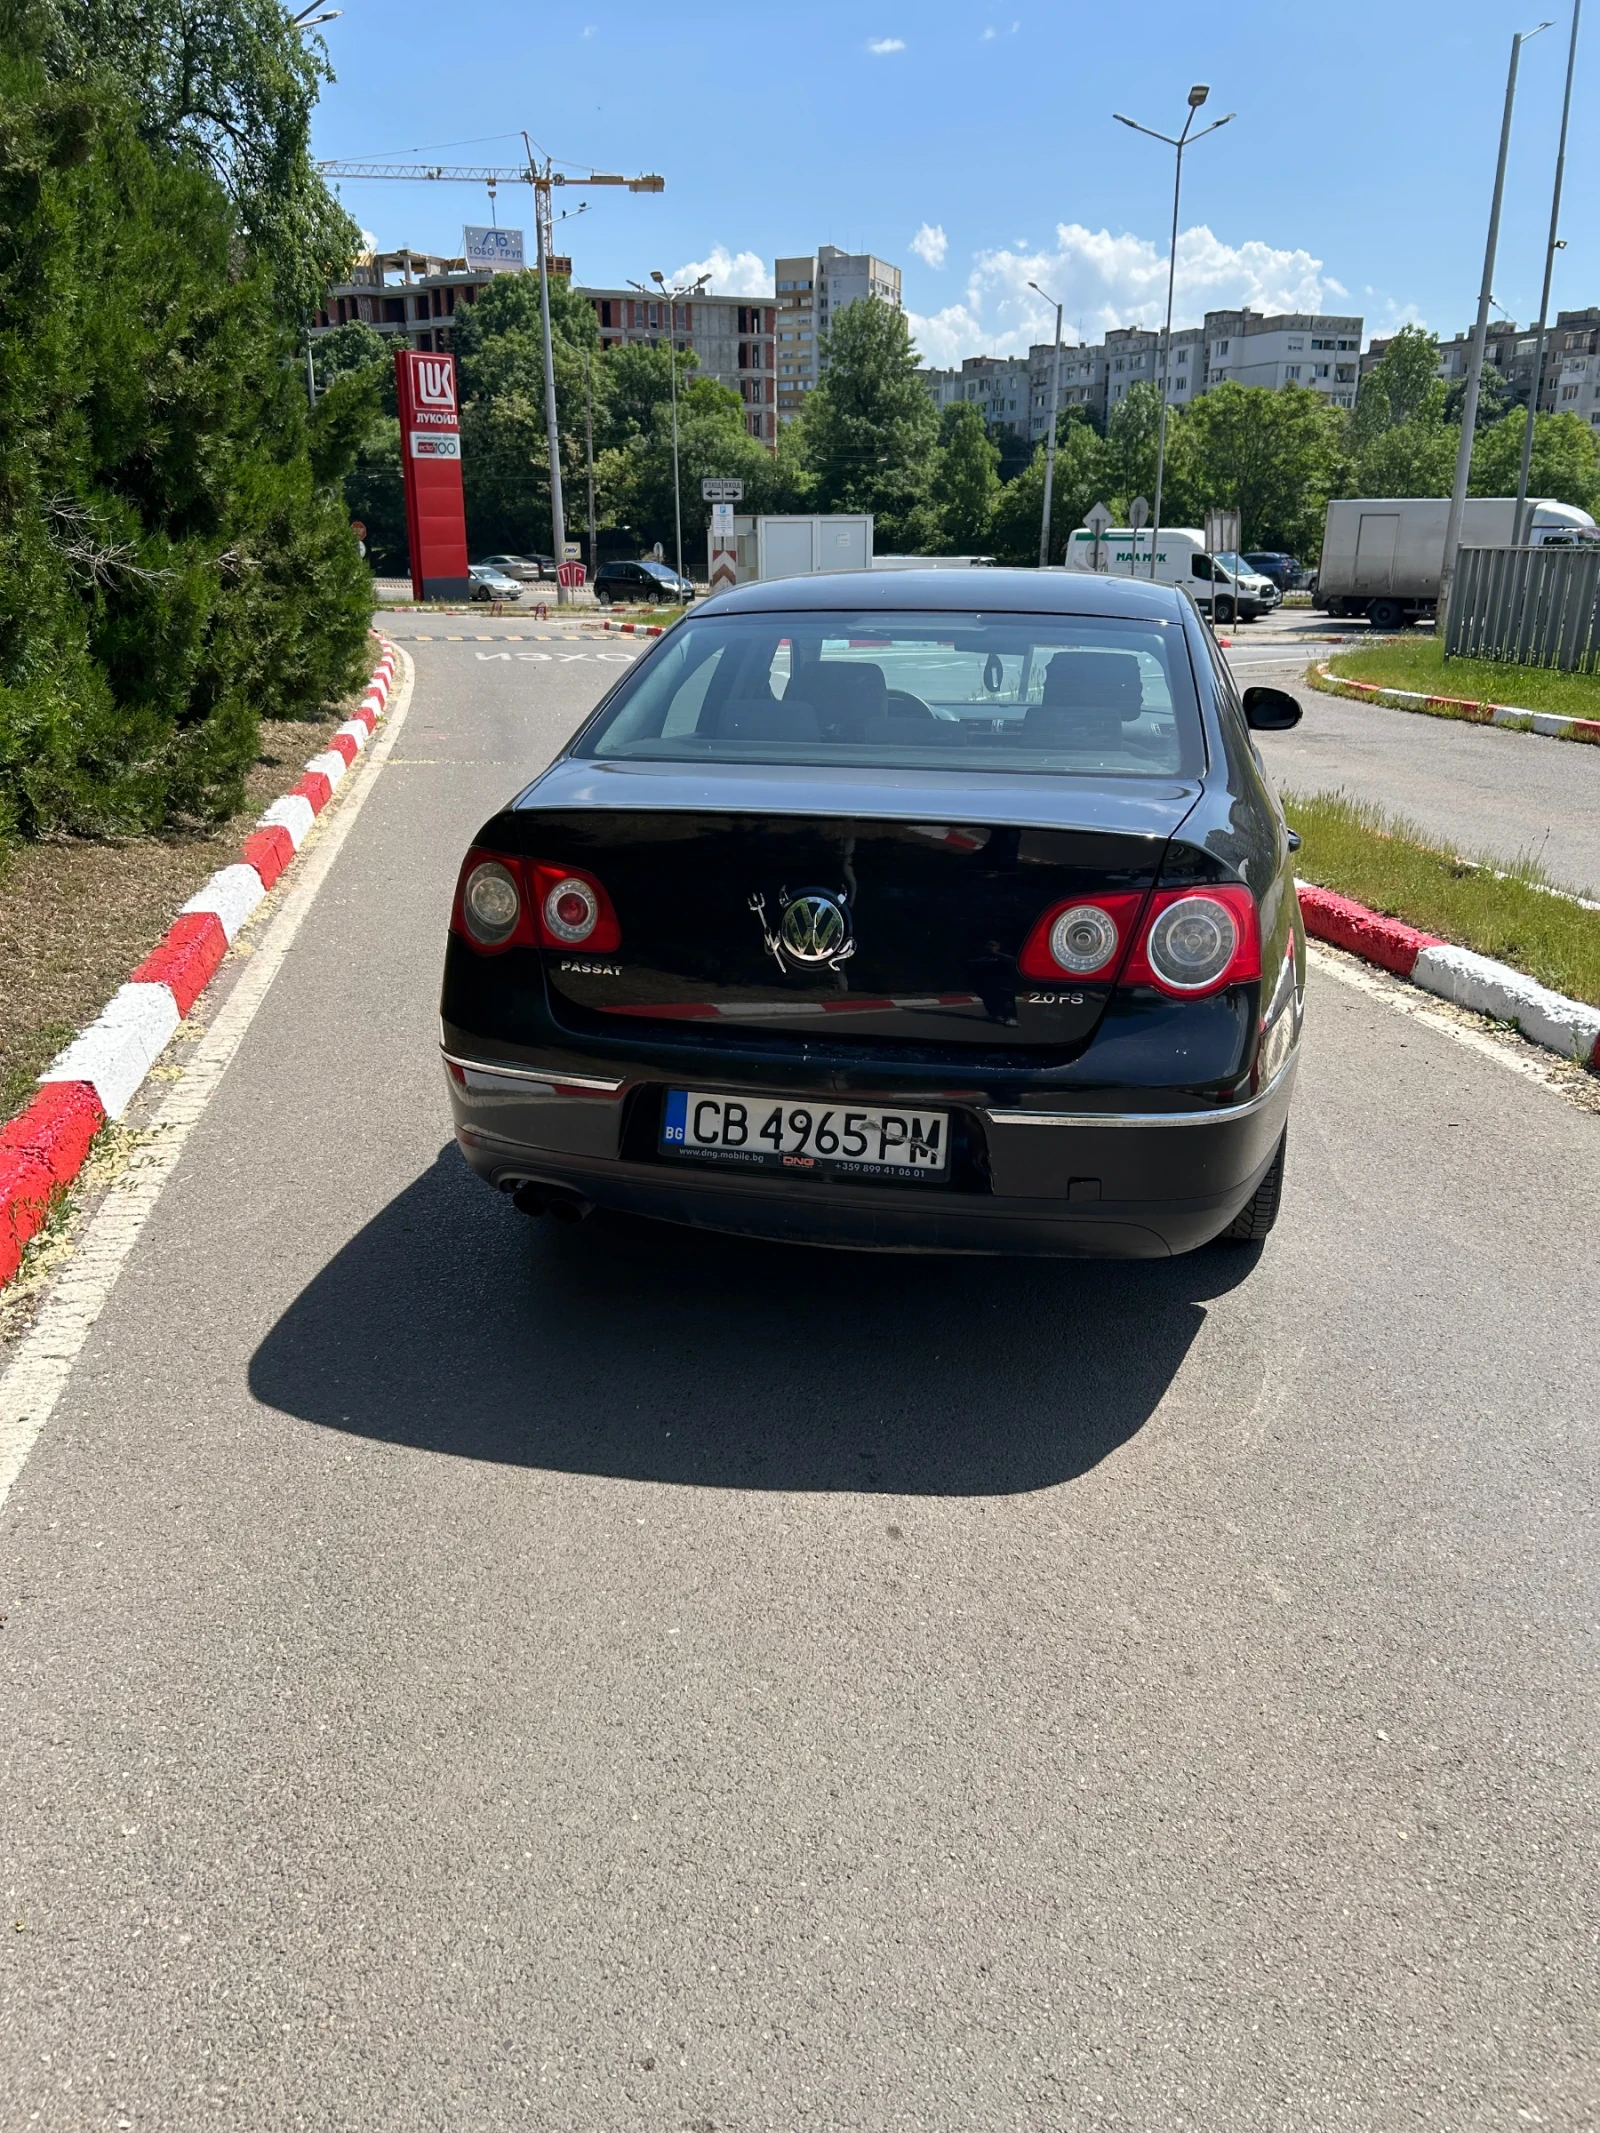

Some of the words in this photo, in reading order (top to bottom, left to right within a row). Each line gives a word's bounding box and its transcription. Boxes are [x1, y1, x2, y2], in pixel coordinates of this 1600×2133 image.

[468, 246, 495, 256] ТОБО
[500, 249, 522, 259] ГРУП
[416, 412, 458, 425] ЛУКОЙЛ
[703, 481, 722, 489] ИЗХОД
[723, 481, 742, 489] ВХОД
[561, 960, 623, 976] PASSAT
[665, 1126, 684, 1140] BG
[760, 1107, 868, 1157] 4965
[679, 1147, 764, 1163] www.dng.mobile.bg
[782, 1155, 815, 1166] DNG
[834, 1162, 860, 1171] +359
[862, 1164, 881, 1173] 899
[883, 1166, 895, 1175] 41
[898, 1168, 911, 1177] 06
[913, 1169, 925, 1178] 01
